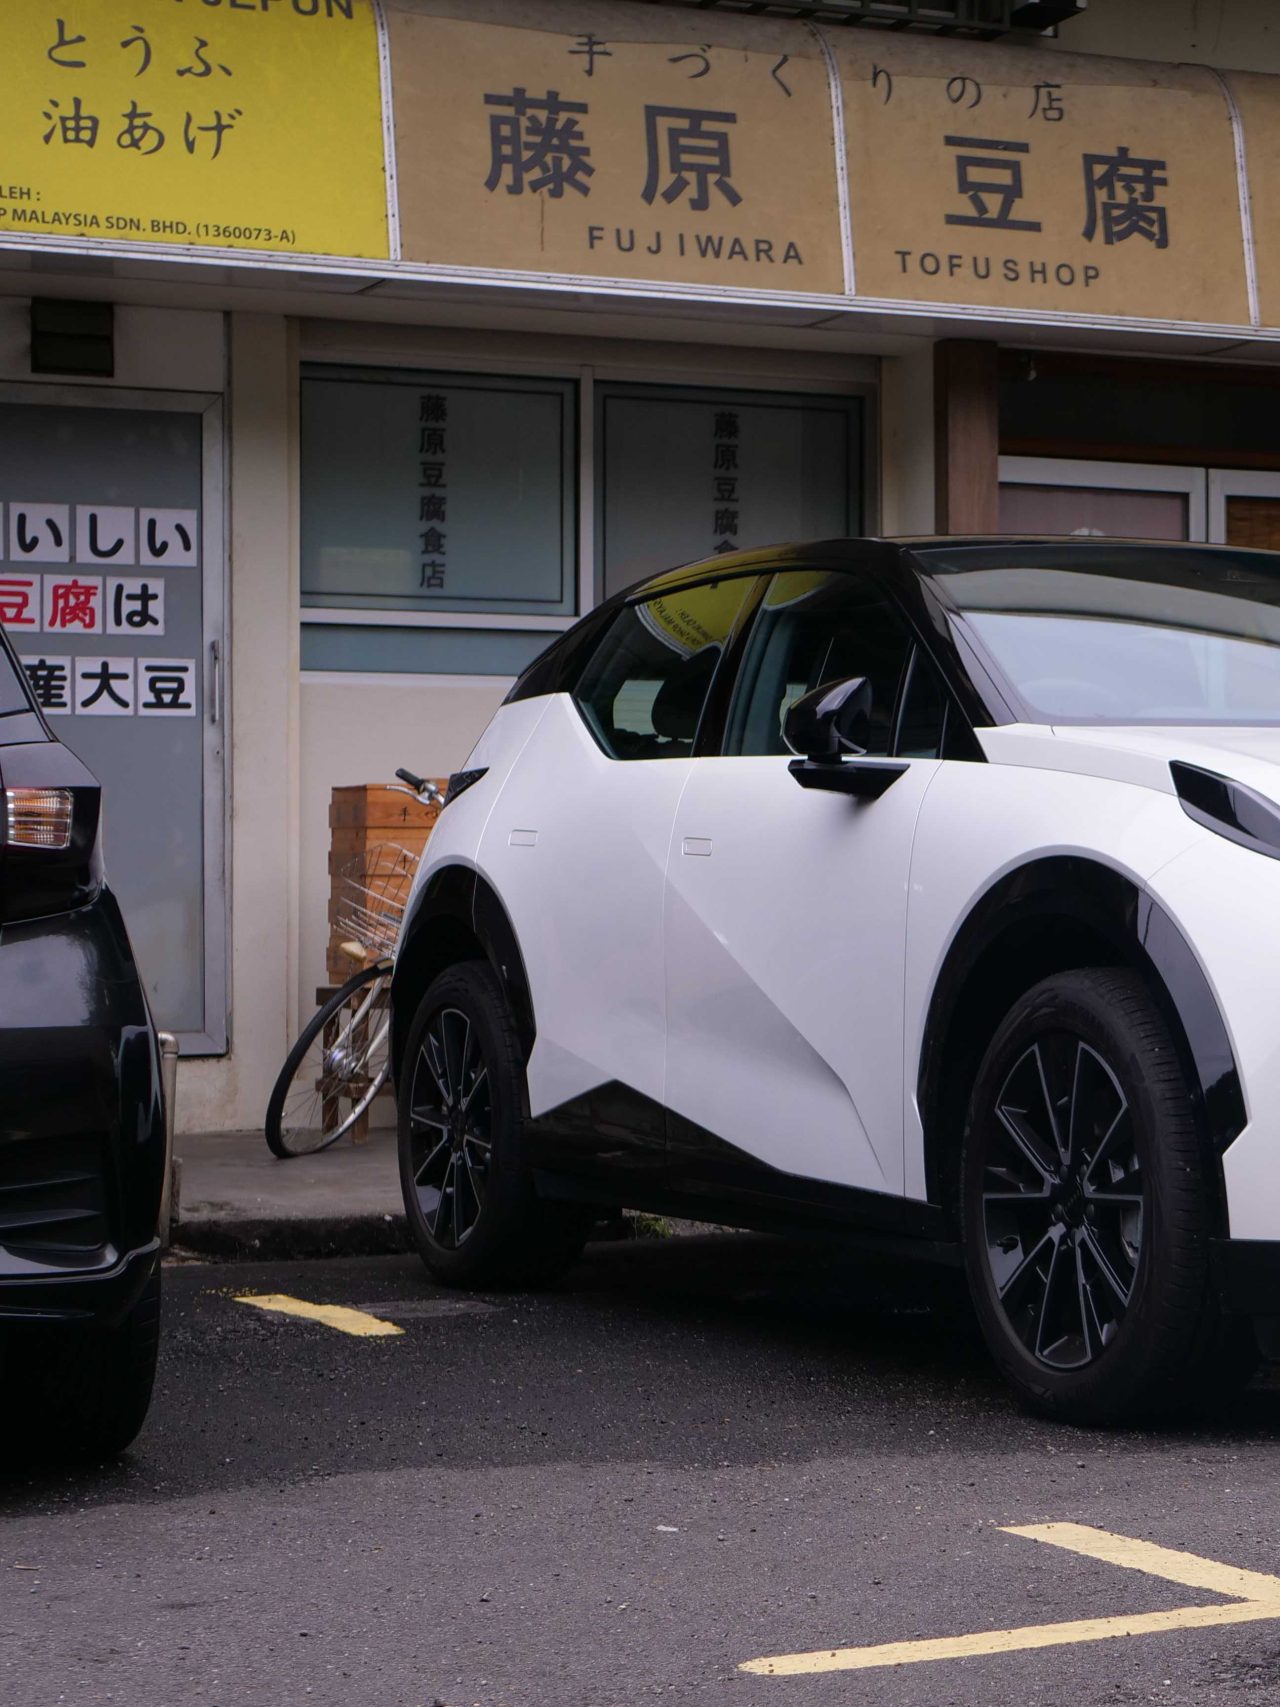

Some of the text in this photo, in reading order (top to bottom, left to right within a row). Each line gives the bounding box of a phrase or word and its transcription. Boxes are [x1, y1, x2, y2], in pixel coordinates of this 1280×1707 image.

[47, 18, 233, 78] とうふ
[42, 96, 243, 161] 油あげ
[12, 208, 101, 228] MALAYSIA
[105, 215, 146, 232] SDN.
[151, 219, 192, 236] BHD.
[196, 222, 296, 245] (1360073-A)
[588, 225, 804, 266] FUJIWARA
[895, 250, 1101, 288] TOFUSHOP
[418, 394, 447, 589] 藤原豆腐食店
[0, 579, 159, 629] 豆腐は
